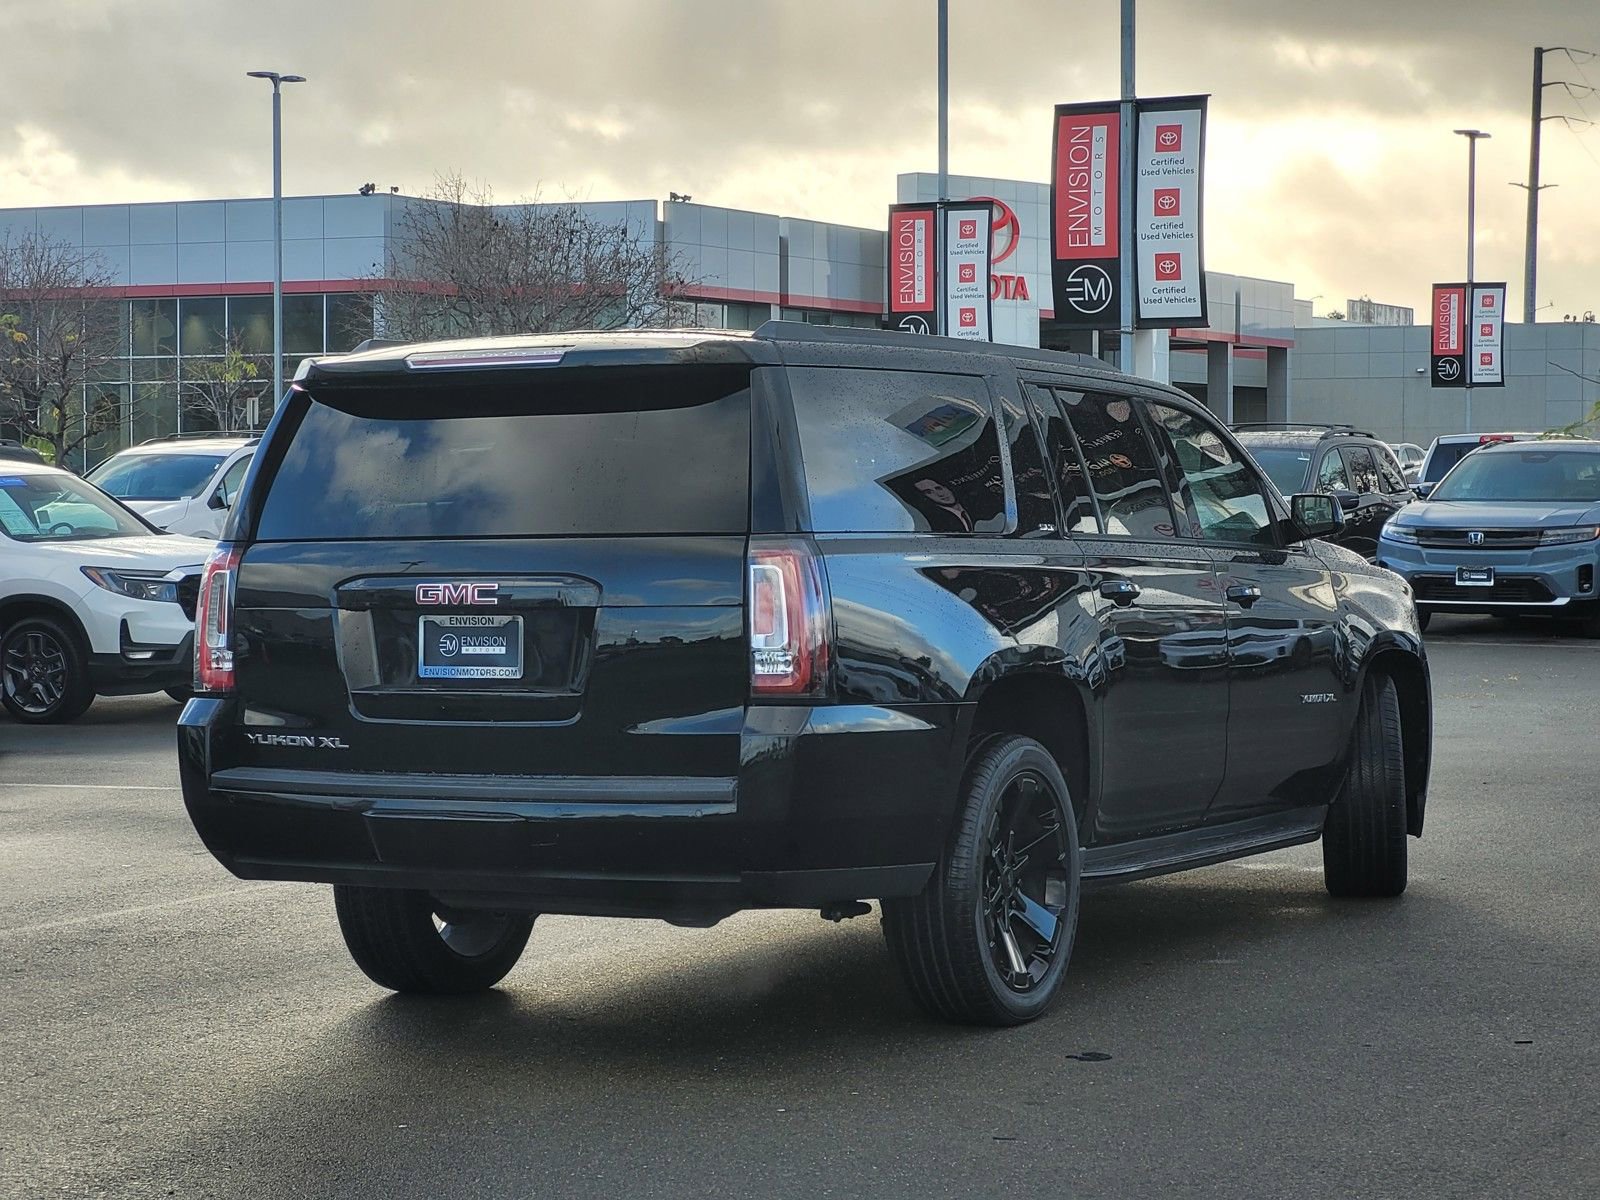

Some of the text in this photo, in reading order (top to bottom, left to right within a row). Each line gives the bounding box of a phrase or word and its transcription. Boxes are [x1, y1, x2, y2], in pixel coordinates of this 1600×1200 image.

[1150, 157, 1185, 166] Certified
[1141, 167, 1195, 176] Used Vehicles
[1068, 126, 1091, 248] ENVISION
[1094, 136, 1104, 236] MOTORS
[1150, 222, 1184, 230] Certified
[1141, 231, 1194, 240] Used Vehicles
[900, 219, 914, 304] ENVISION
[1152, 286, 1186, 295] Certified
[1143, 295, 1197, 304] Used Vehicles
[1439, 293, 1450, 350] ENVISION
[415, 583, 499, 605] GMC
[449, 616, 495, 626] ENVISION
[461, 636, 507, 646] ENVISION
[423, 668, 518, 677] ENVISIONMOTORS.COM
[244, 733, 350, 749] YUKON XL
